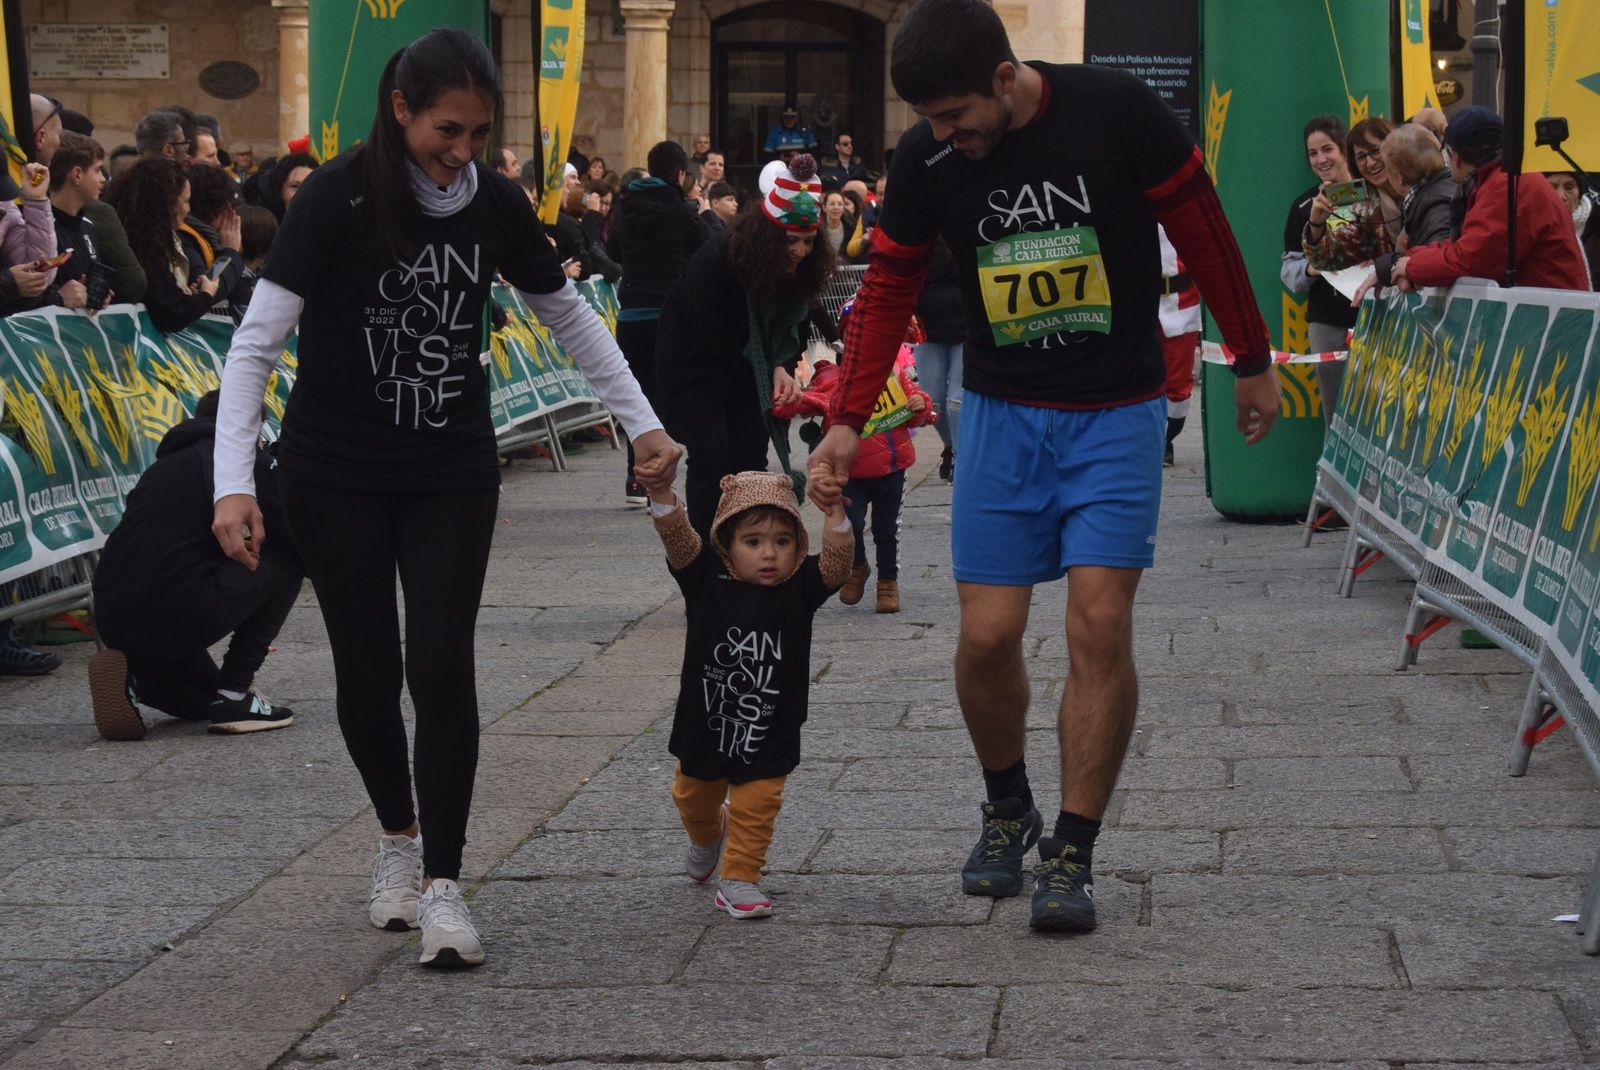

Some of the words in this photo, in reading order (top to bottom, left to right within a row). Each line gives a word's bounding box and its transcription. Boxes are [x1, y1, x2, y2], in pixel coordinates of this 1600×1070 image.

[1091, 55, 1117, 63] Desde
[1118, 55, 1125, 63] la
[1153, 56, 1192, 65] Municipal
[1137, 67, 1145, 75] te
[1146, 66, 1190, 76] ofrecemos
[1156, 79, 1187, 87] cuando
[925, 144, 953, 167] luanvi
[978, 175, 1091, 244] SAN
[1014, 233, 1081, 251] FUNDACION
[1015, 244, 1042, 261] CAJA
[1045, 239, 1083, 257] RURAL
[993, 264, 1089, 315] 707
[364, 307, 375, 315] 31
[369, 316, 395, 324] 2022
[1028, 315, 1061, 331] CAJA
[1064, 312, 1107, 326] RURAL
[452, 352, 469, 361] ORA
[714, 626, 782, 667] SAN
